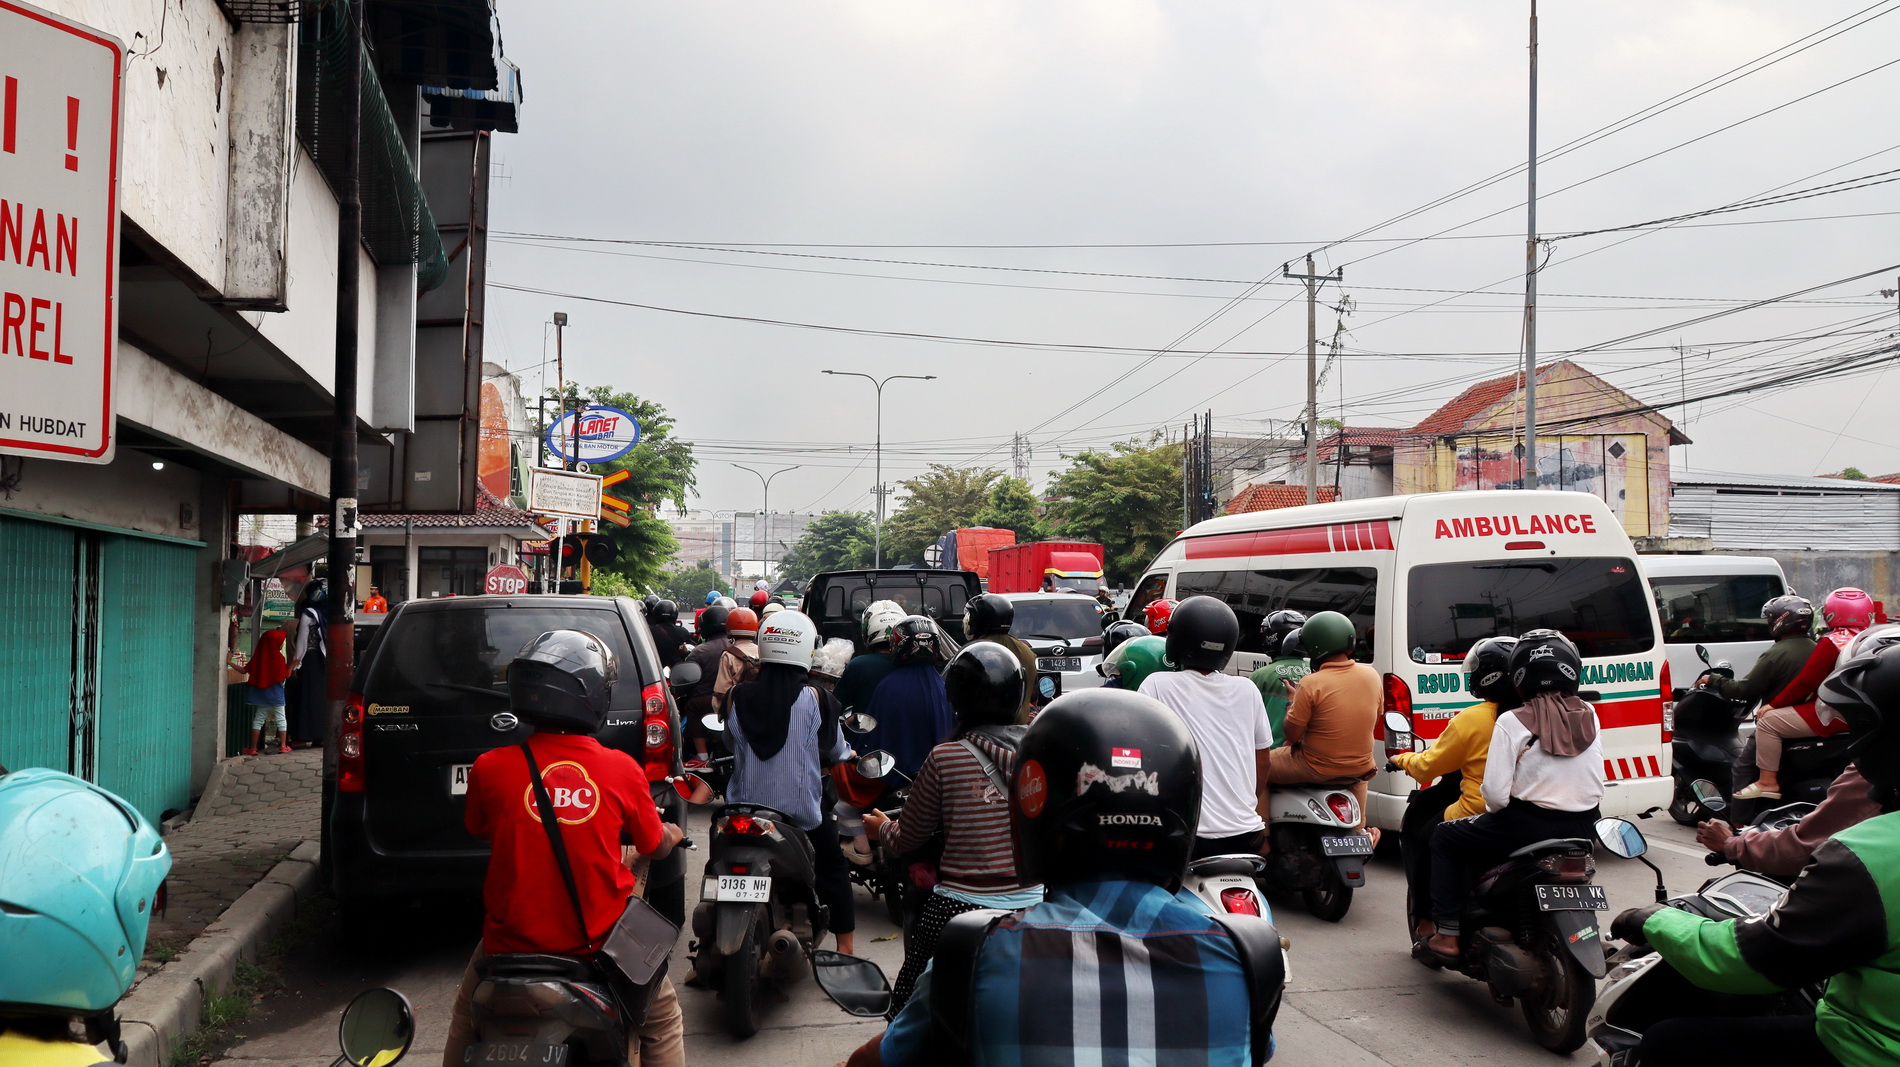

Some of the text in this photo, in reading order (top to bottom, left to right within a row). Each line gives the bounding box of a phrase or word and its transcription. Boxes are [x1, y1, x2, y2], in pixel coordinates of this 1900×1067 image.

[20, 415, 87, 438] HUBDAT
[596, 431, 614, 440] BAN
[597, 443, 619, 451] MOTOR
[1434, 514, 1597, 539] AMBULANCE
[488, 576, 525, 594] STOP
[1051, 659, 1067, 667] 1428
[1560, 664, 1577, 680] INK
[1417, 673, 1461, 694] RSUD
[1481, 672, 1500, 686] INK
[1424, 712, 1454, 720] HIACE
[374, 724, 419, 732] XENIA
[1099, 814, 1163, 826] HONDA
[1332, 838, 1354, 847] 5990
[1358, 838, 1368, 846] ZT
[721, 879, 767, 890] 3136 NH
[1539, 887, 1604, 899] G 5791 VK
[485, 1043, 529, 1062] 2604
[542, 1045, 564, 1065] JV
